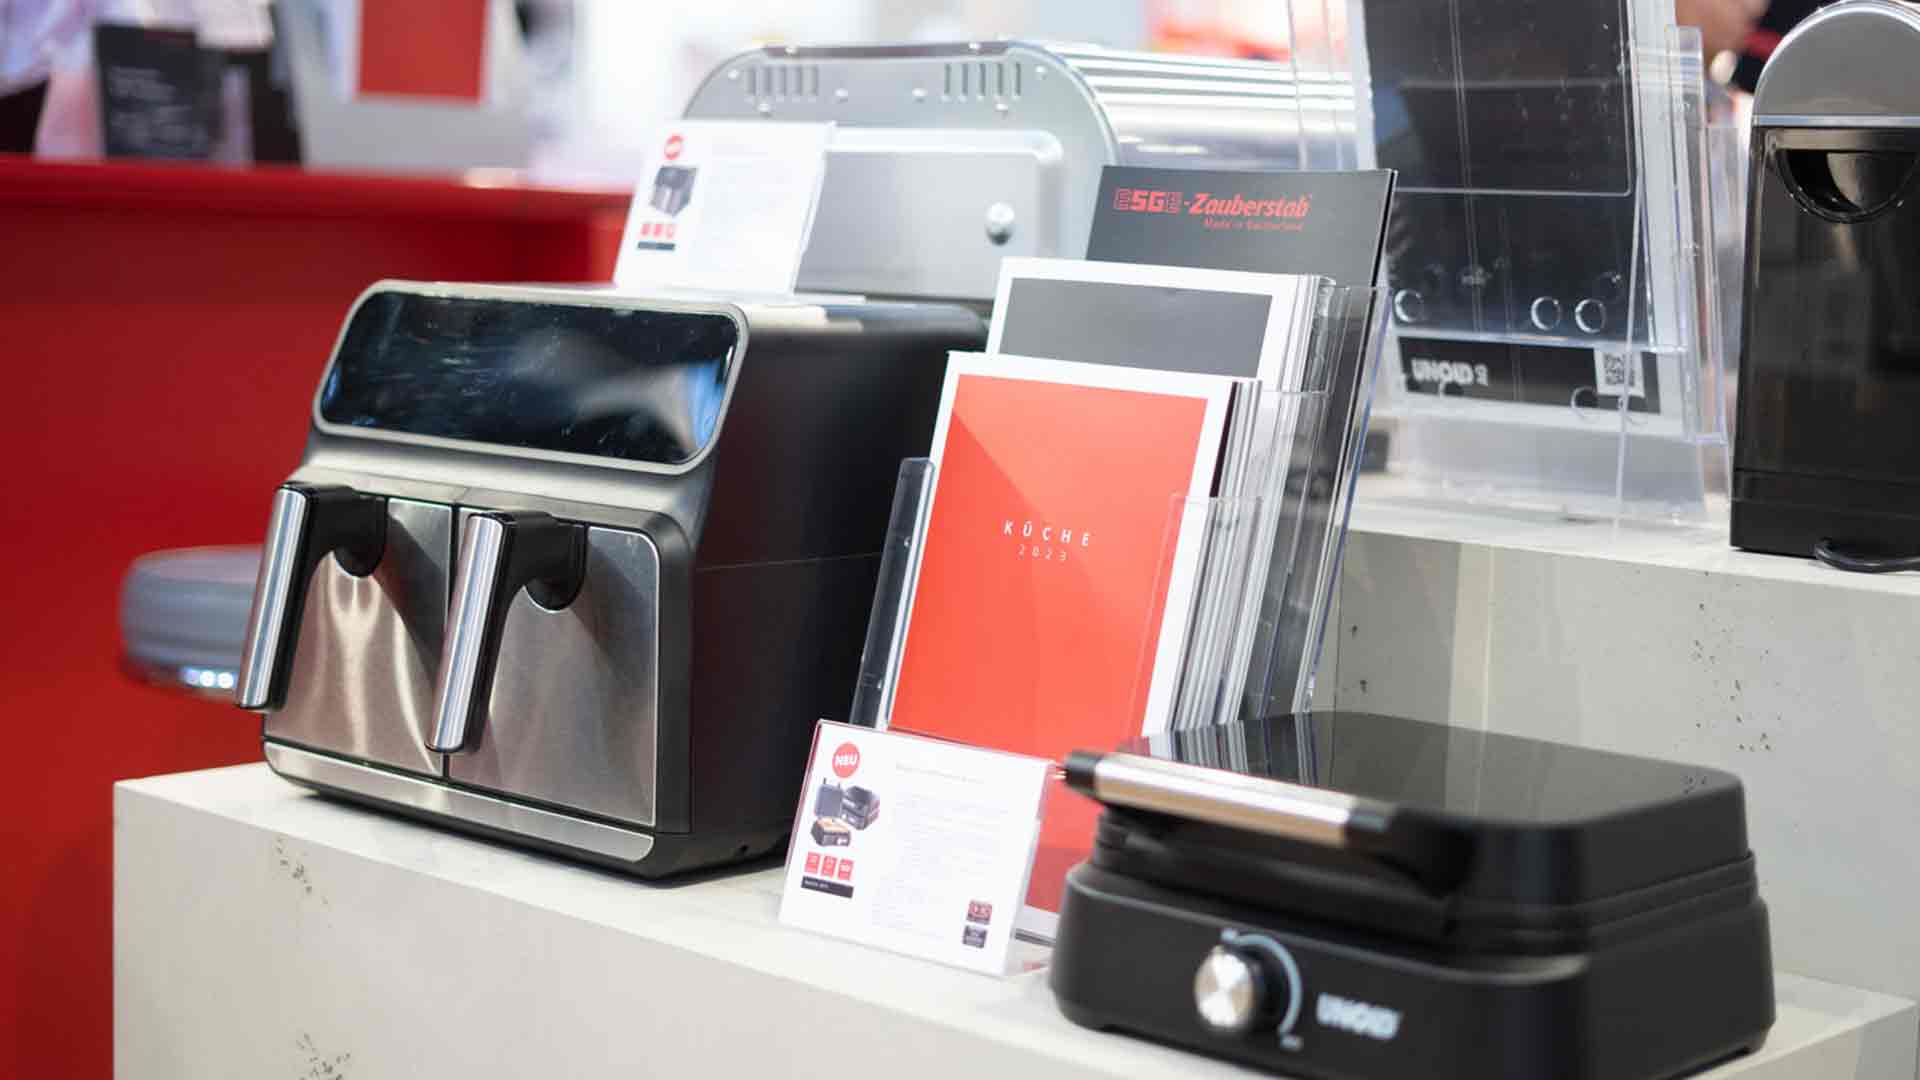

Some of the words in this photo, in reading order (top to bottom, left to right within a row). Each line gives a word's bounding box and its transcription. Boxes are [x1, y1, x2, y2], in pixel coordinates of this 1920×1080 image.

[1004, 519, 1090, 547] KÜCHE
[1019, 544, 1068, 561] 2023
[835, 752, 858, 766] NEU
